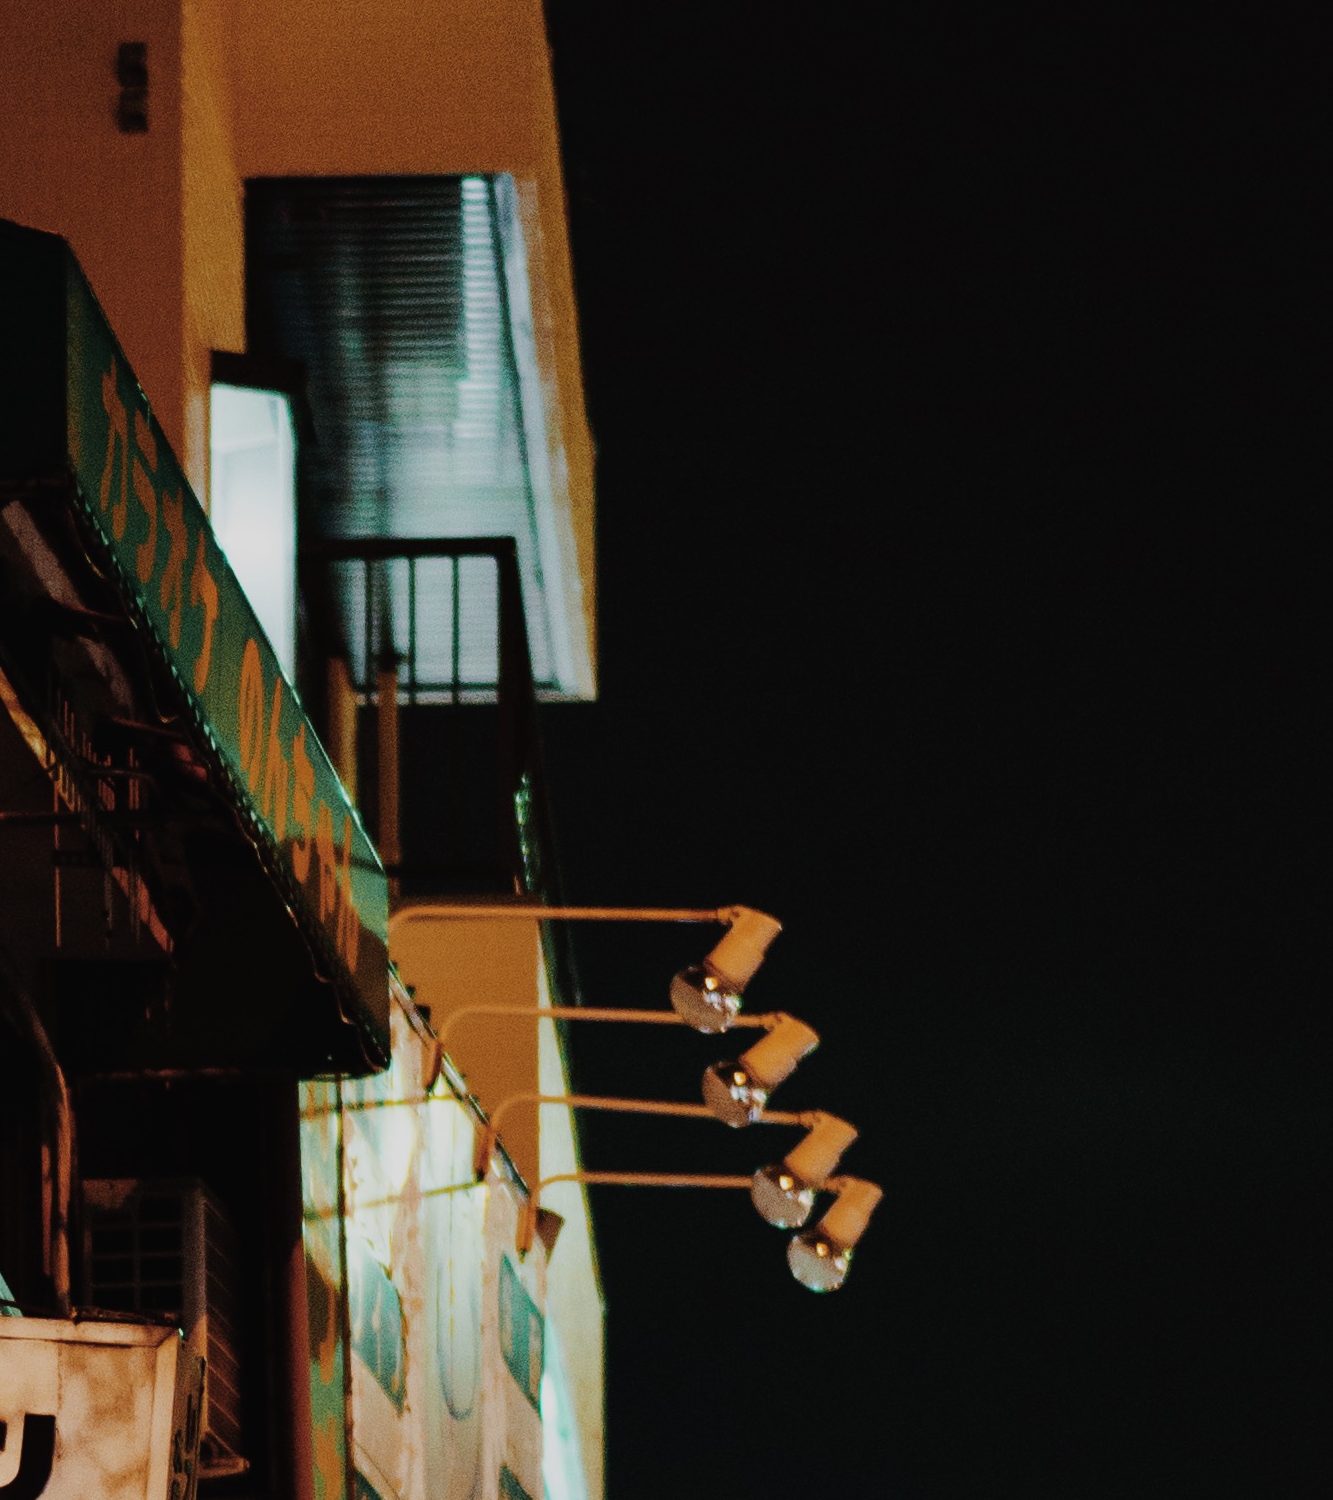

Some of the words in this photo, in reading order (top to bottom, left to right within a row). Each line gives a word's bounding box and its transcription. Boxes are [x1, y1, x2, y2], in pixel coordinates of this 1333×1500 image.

[99, 352, 219, 694] カラオケ
[237, 637, 359, 972] のんちゃん
